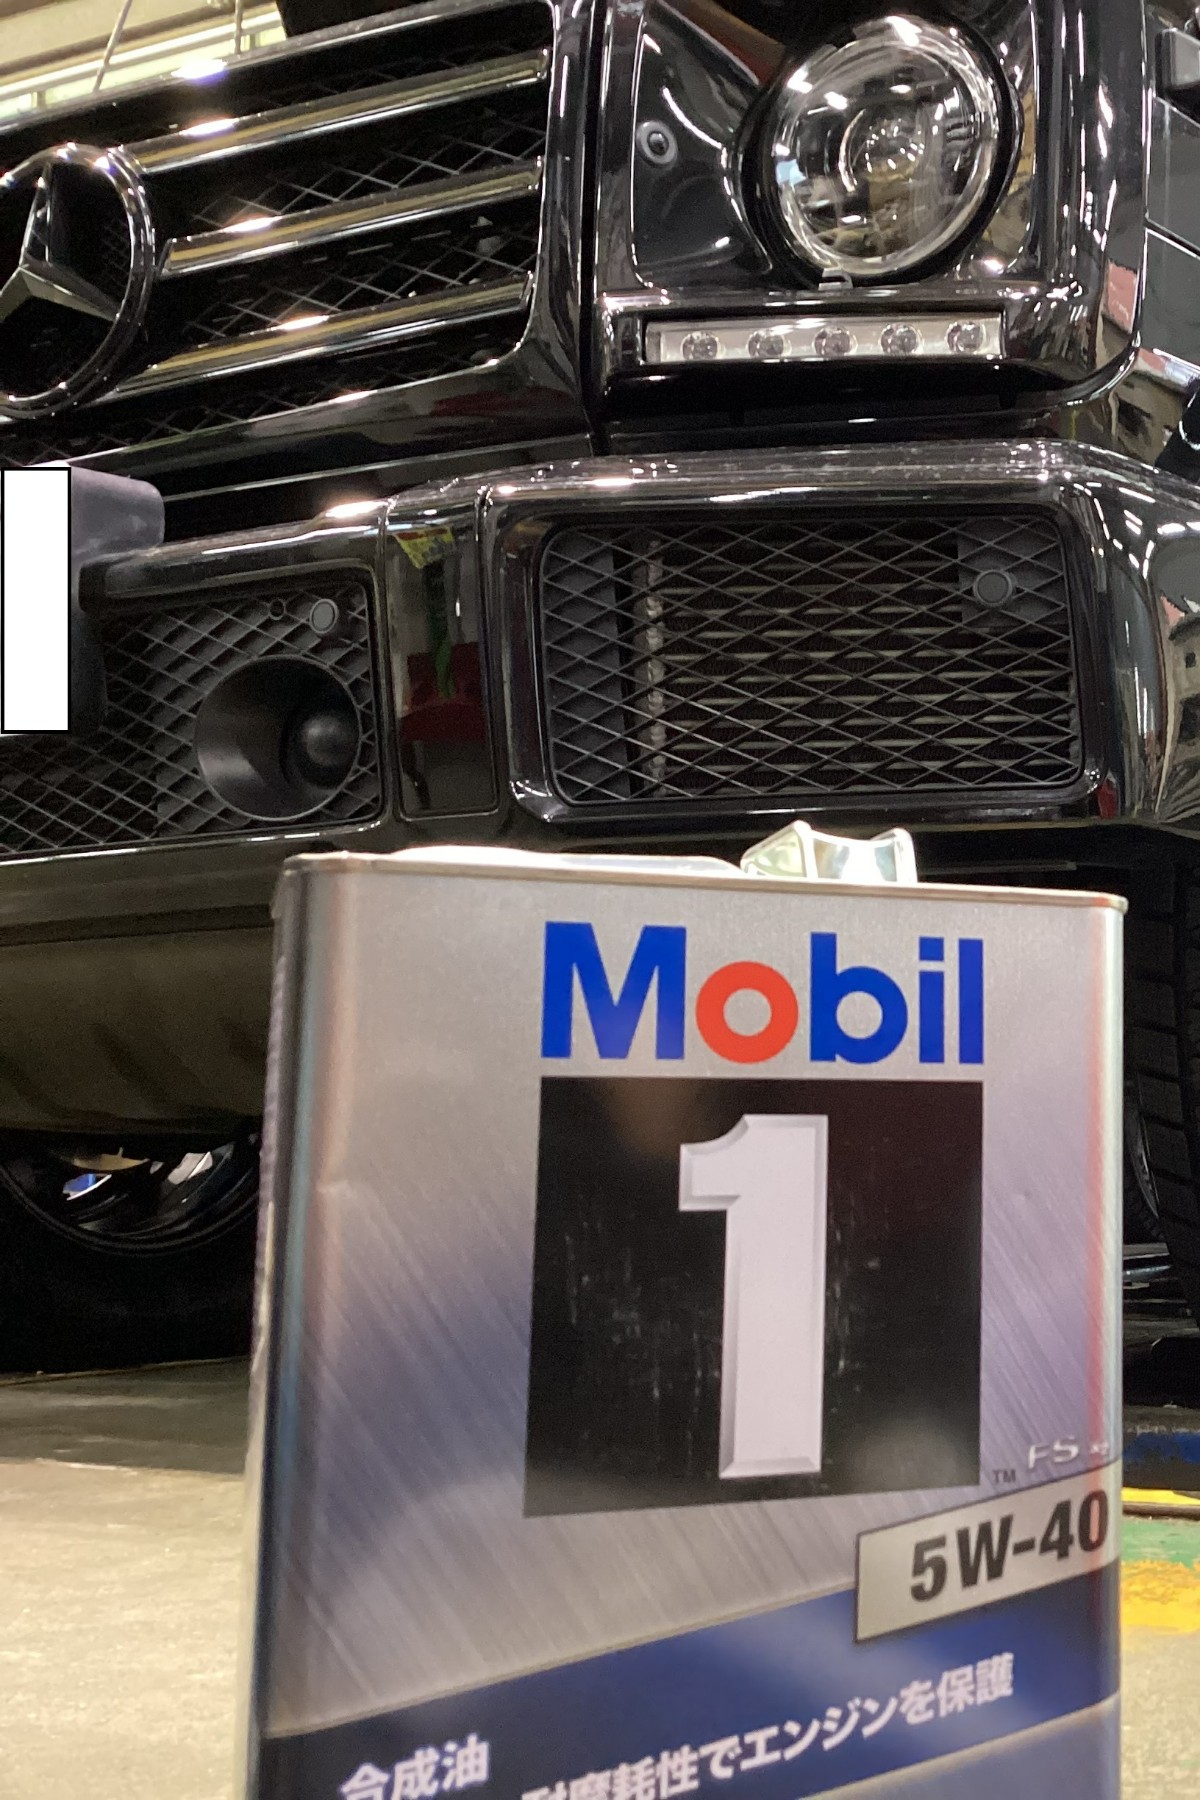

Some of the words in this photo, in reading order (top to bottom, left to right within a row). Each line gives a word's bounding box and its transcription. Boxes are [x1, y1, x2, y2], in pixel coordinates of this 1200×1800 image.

[541, 921, 984, 1065] Mobil
[679, 1114, 828, 1479] 1
[992, 1468, 1017, 1484] TM
[1028, 1436, 1079, 1469] FS
[910, 1489, 1109, 1603] 5W-40
[339, 1732, 490, 1800] 合成油
